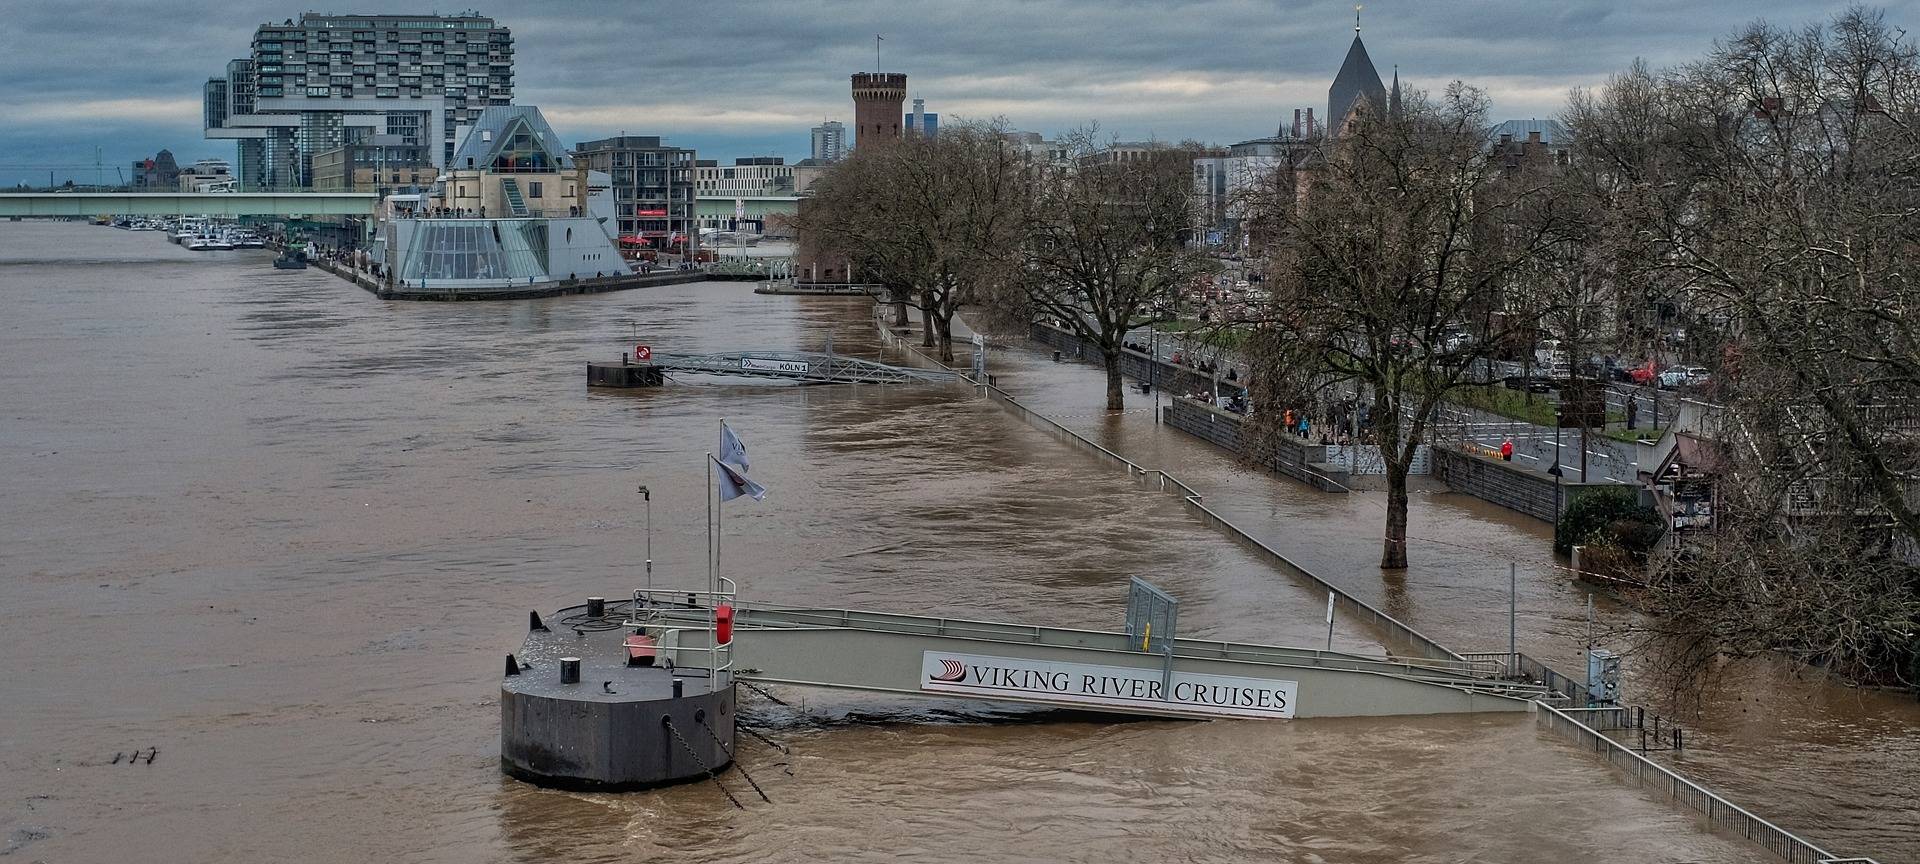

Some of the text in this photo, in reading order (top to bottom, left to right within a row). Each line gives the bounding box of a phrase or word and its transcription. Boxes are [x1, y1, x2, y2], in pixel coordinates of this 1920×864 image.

[779, 362, 800, 371] KÖLN
[972, 665, 1287, 709] VIKING RIVER CRUISES
